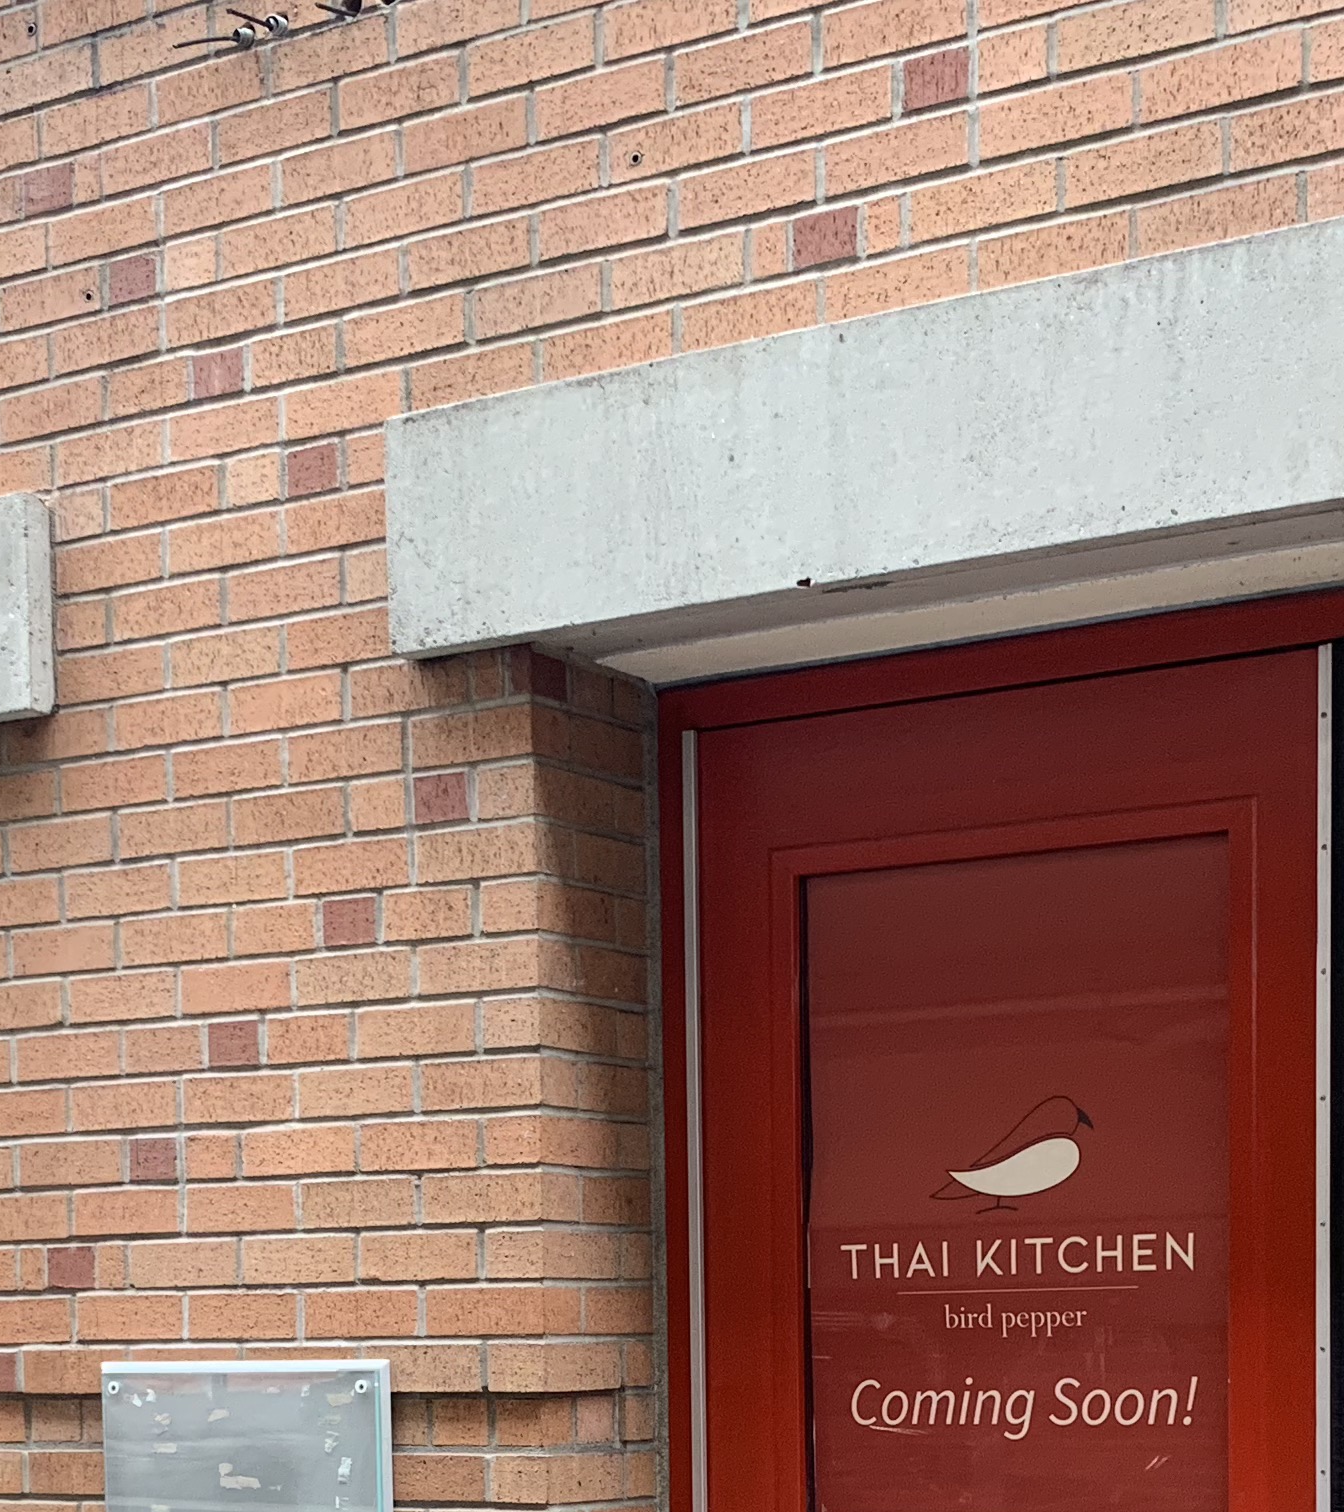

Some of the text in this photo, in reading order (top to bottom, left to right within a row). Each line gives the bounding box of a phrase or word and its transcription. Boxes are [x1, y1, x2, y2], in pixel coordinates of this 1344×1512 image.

[841, 1232, 1195, 1280] THAI KITCHEN
[944, 1304, 1087, 1337] bird pepper
[851, 1376, 1198, 1440] Coming Soon!
